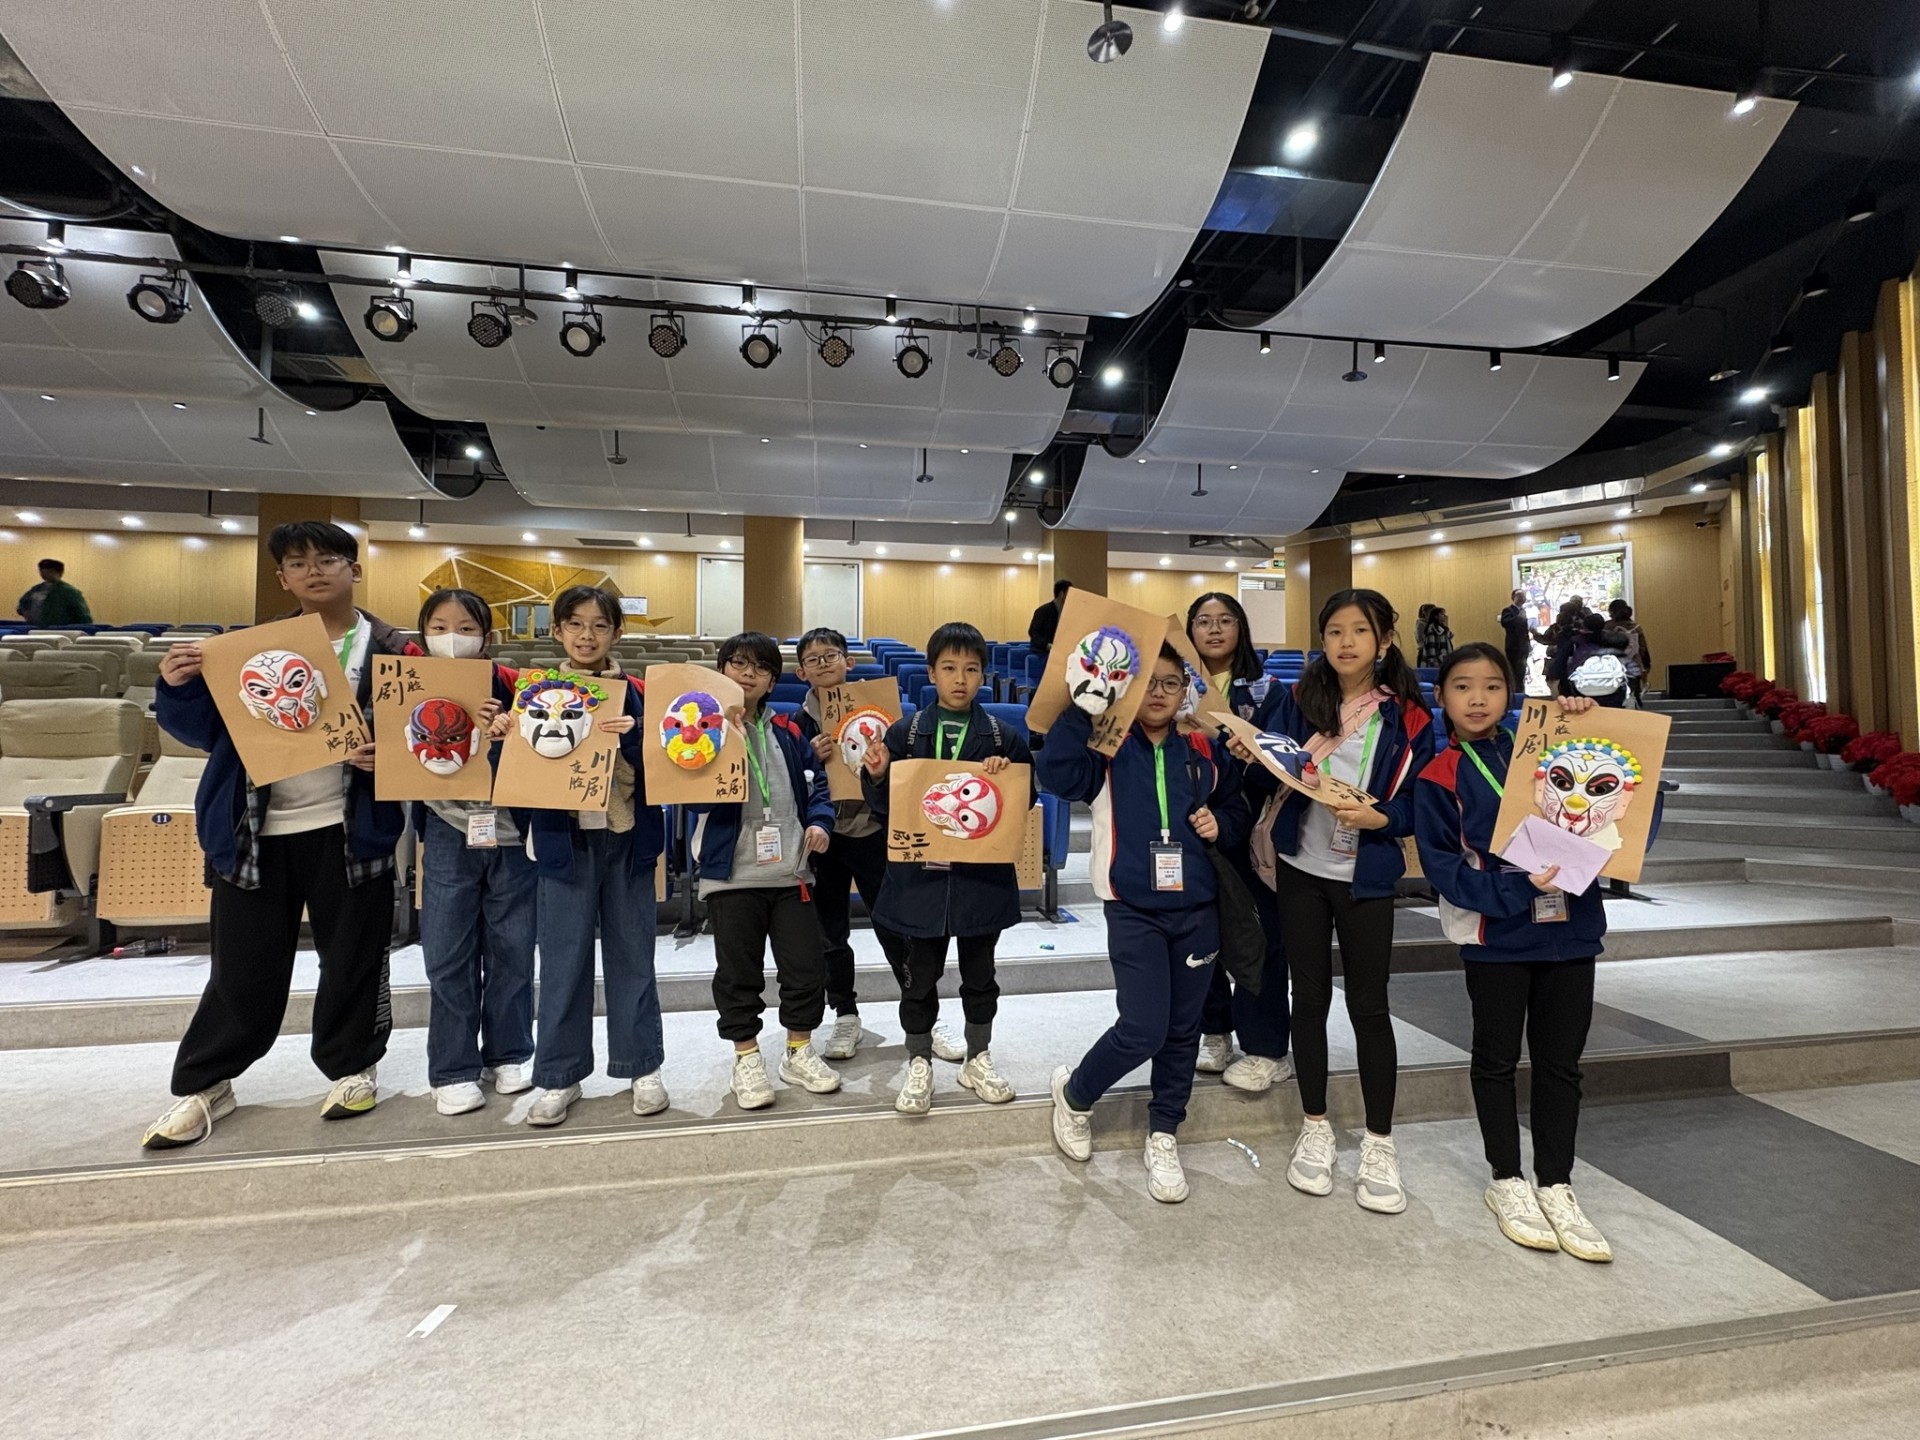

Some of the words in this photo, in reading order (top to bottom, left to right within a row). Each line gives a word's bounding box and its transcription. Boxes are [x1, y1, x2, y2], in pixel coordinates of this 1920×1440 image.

[375, 659, 405, 706] 川剧
[1515, 704, 1548, 759] 川剧
[580, 748, 612, 807] 川剧
[727, 757, 747, 801] 川剧
[156, 814, 167, 823] 11
